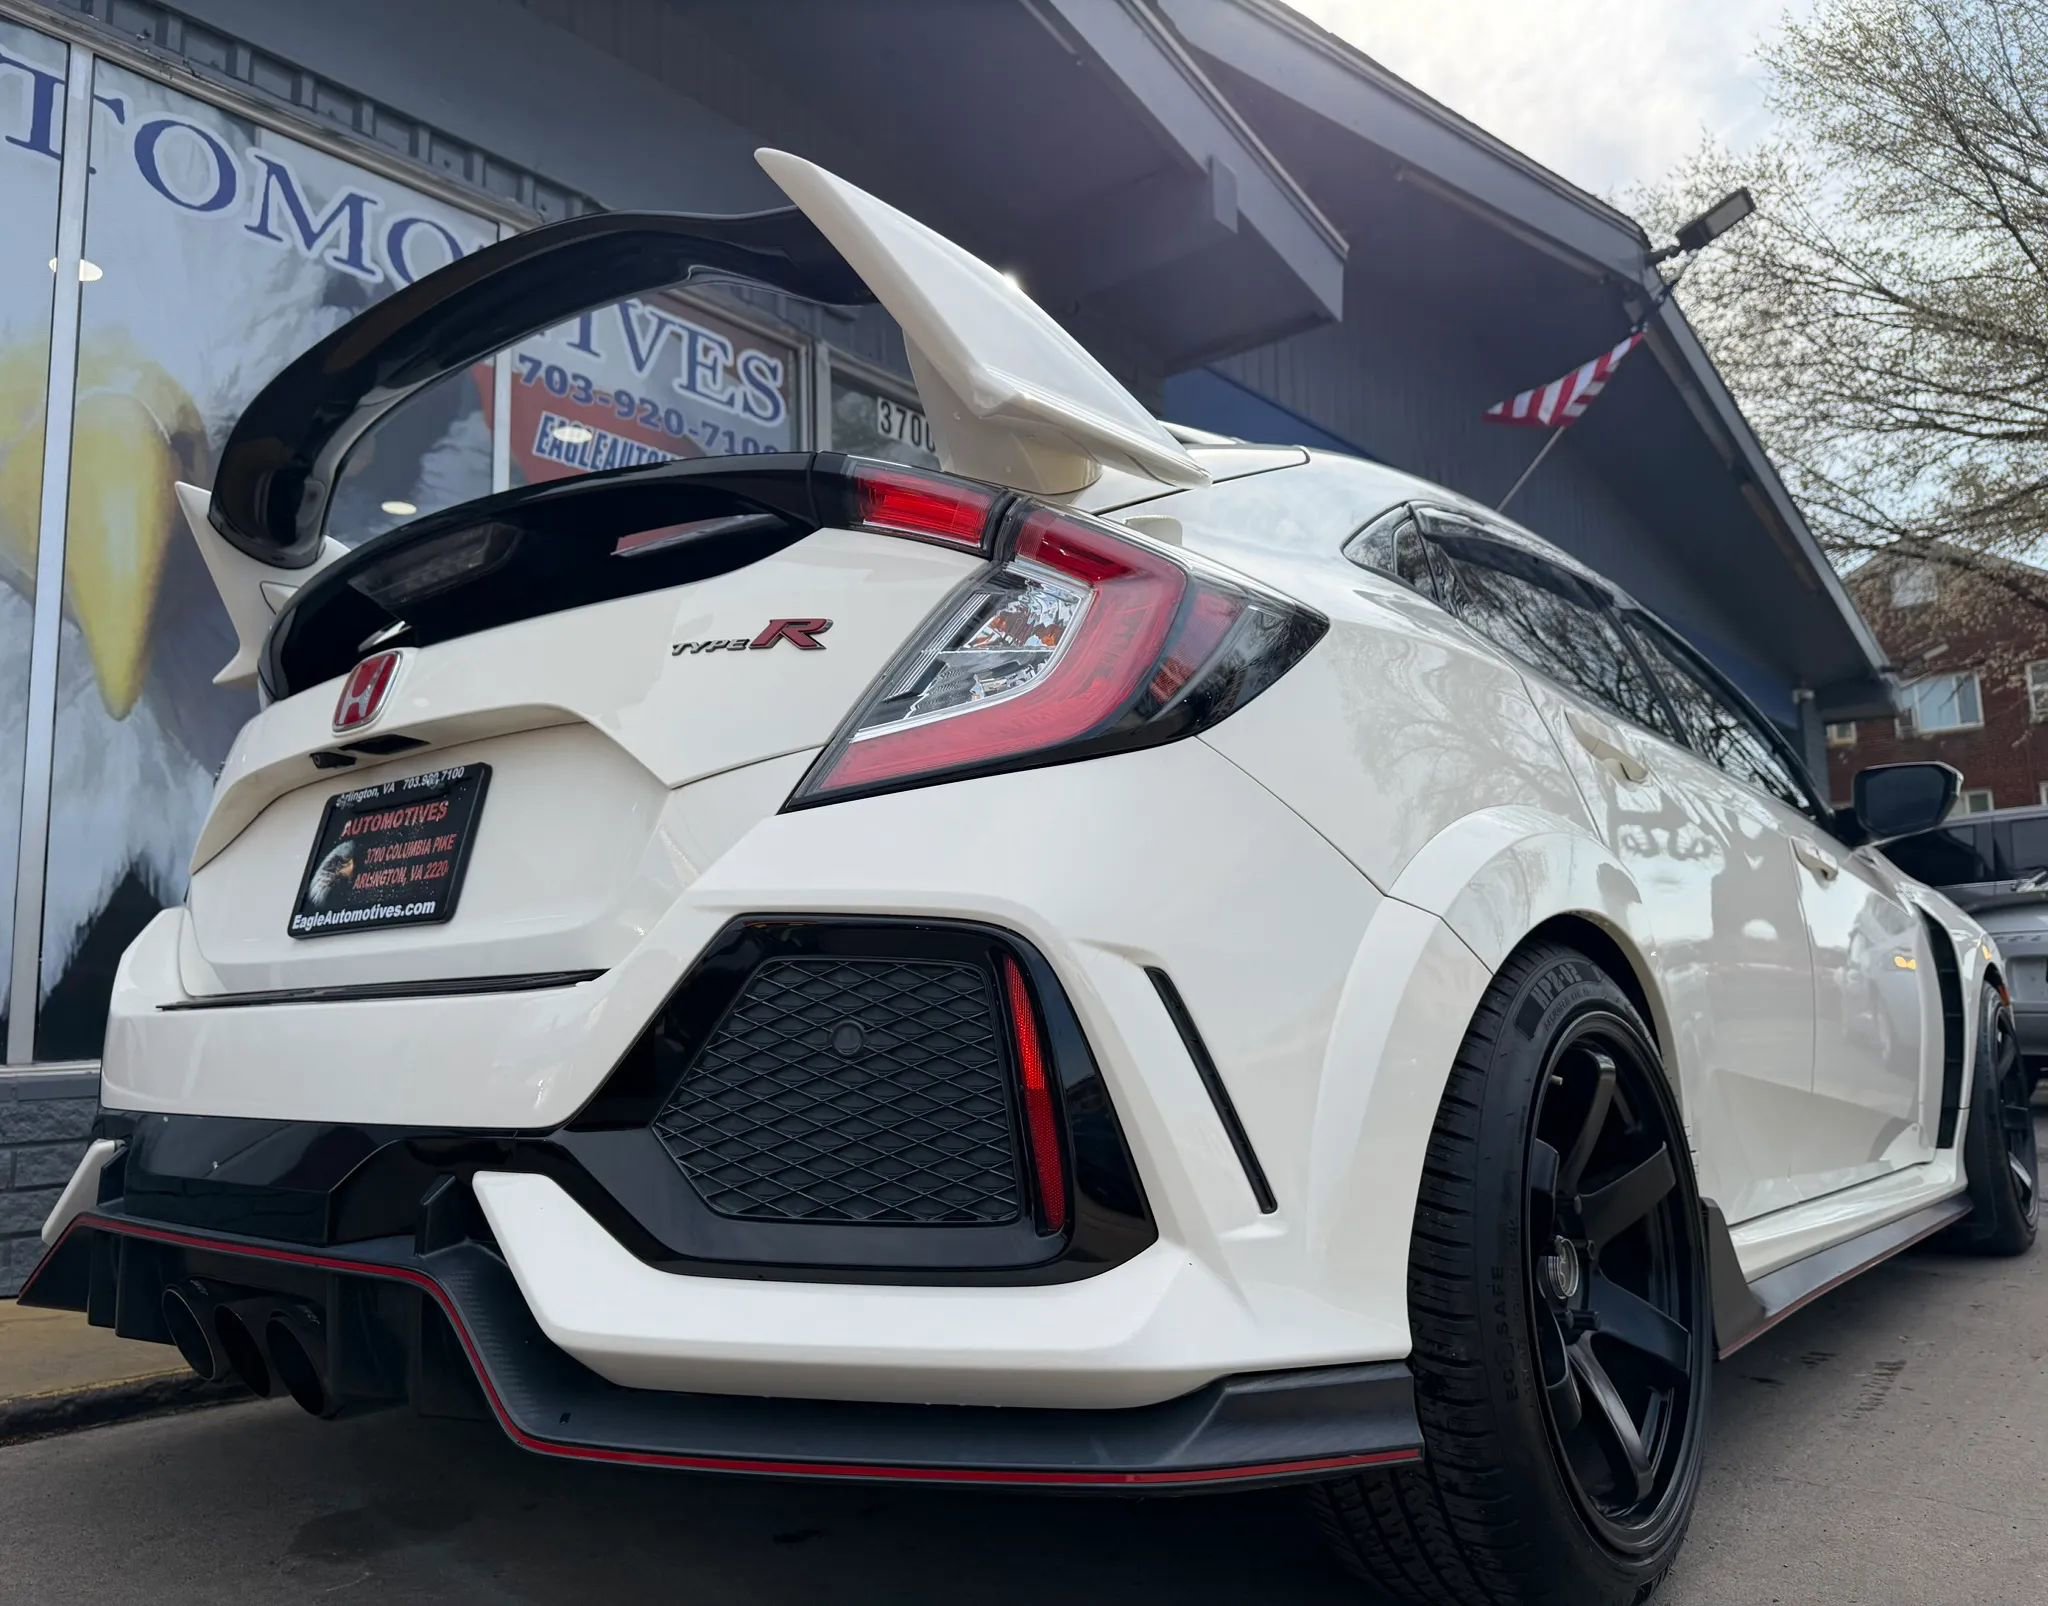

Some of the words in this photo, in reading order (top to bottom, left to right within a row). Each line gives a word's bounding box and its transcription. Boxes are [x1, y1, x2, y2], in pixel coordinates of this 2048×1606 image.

[672, 638, 750, 656] TYPE
[749, 618, 834, 651] R
[383, 782, 395, 794] VA
[341, 801, 449, 837] AUTOMOTIVES
[386, 838, 432, 862] COLUMBIA
[432, 834, 458, 854] PIKE
[411, 863, 425, 881] VA
[292, 900, 436, 931] EagleAutomotives.com
